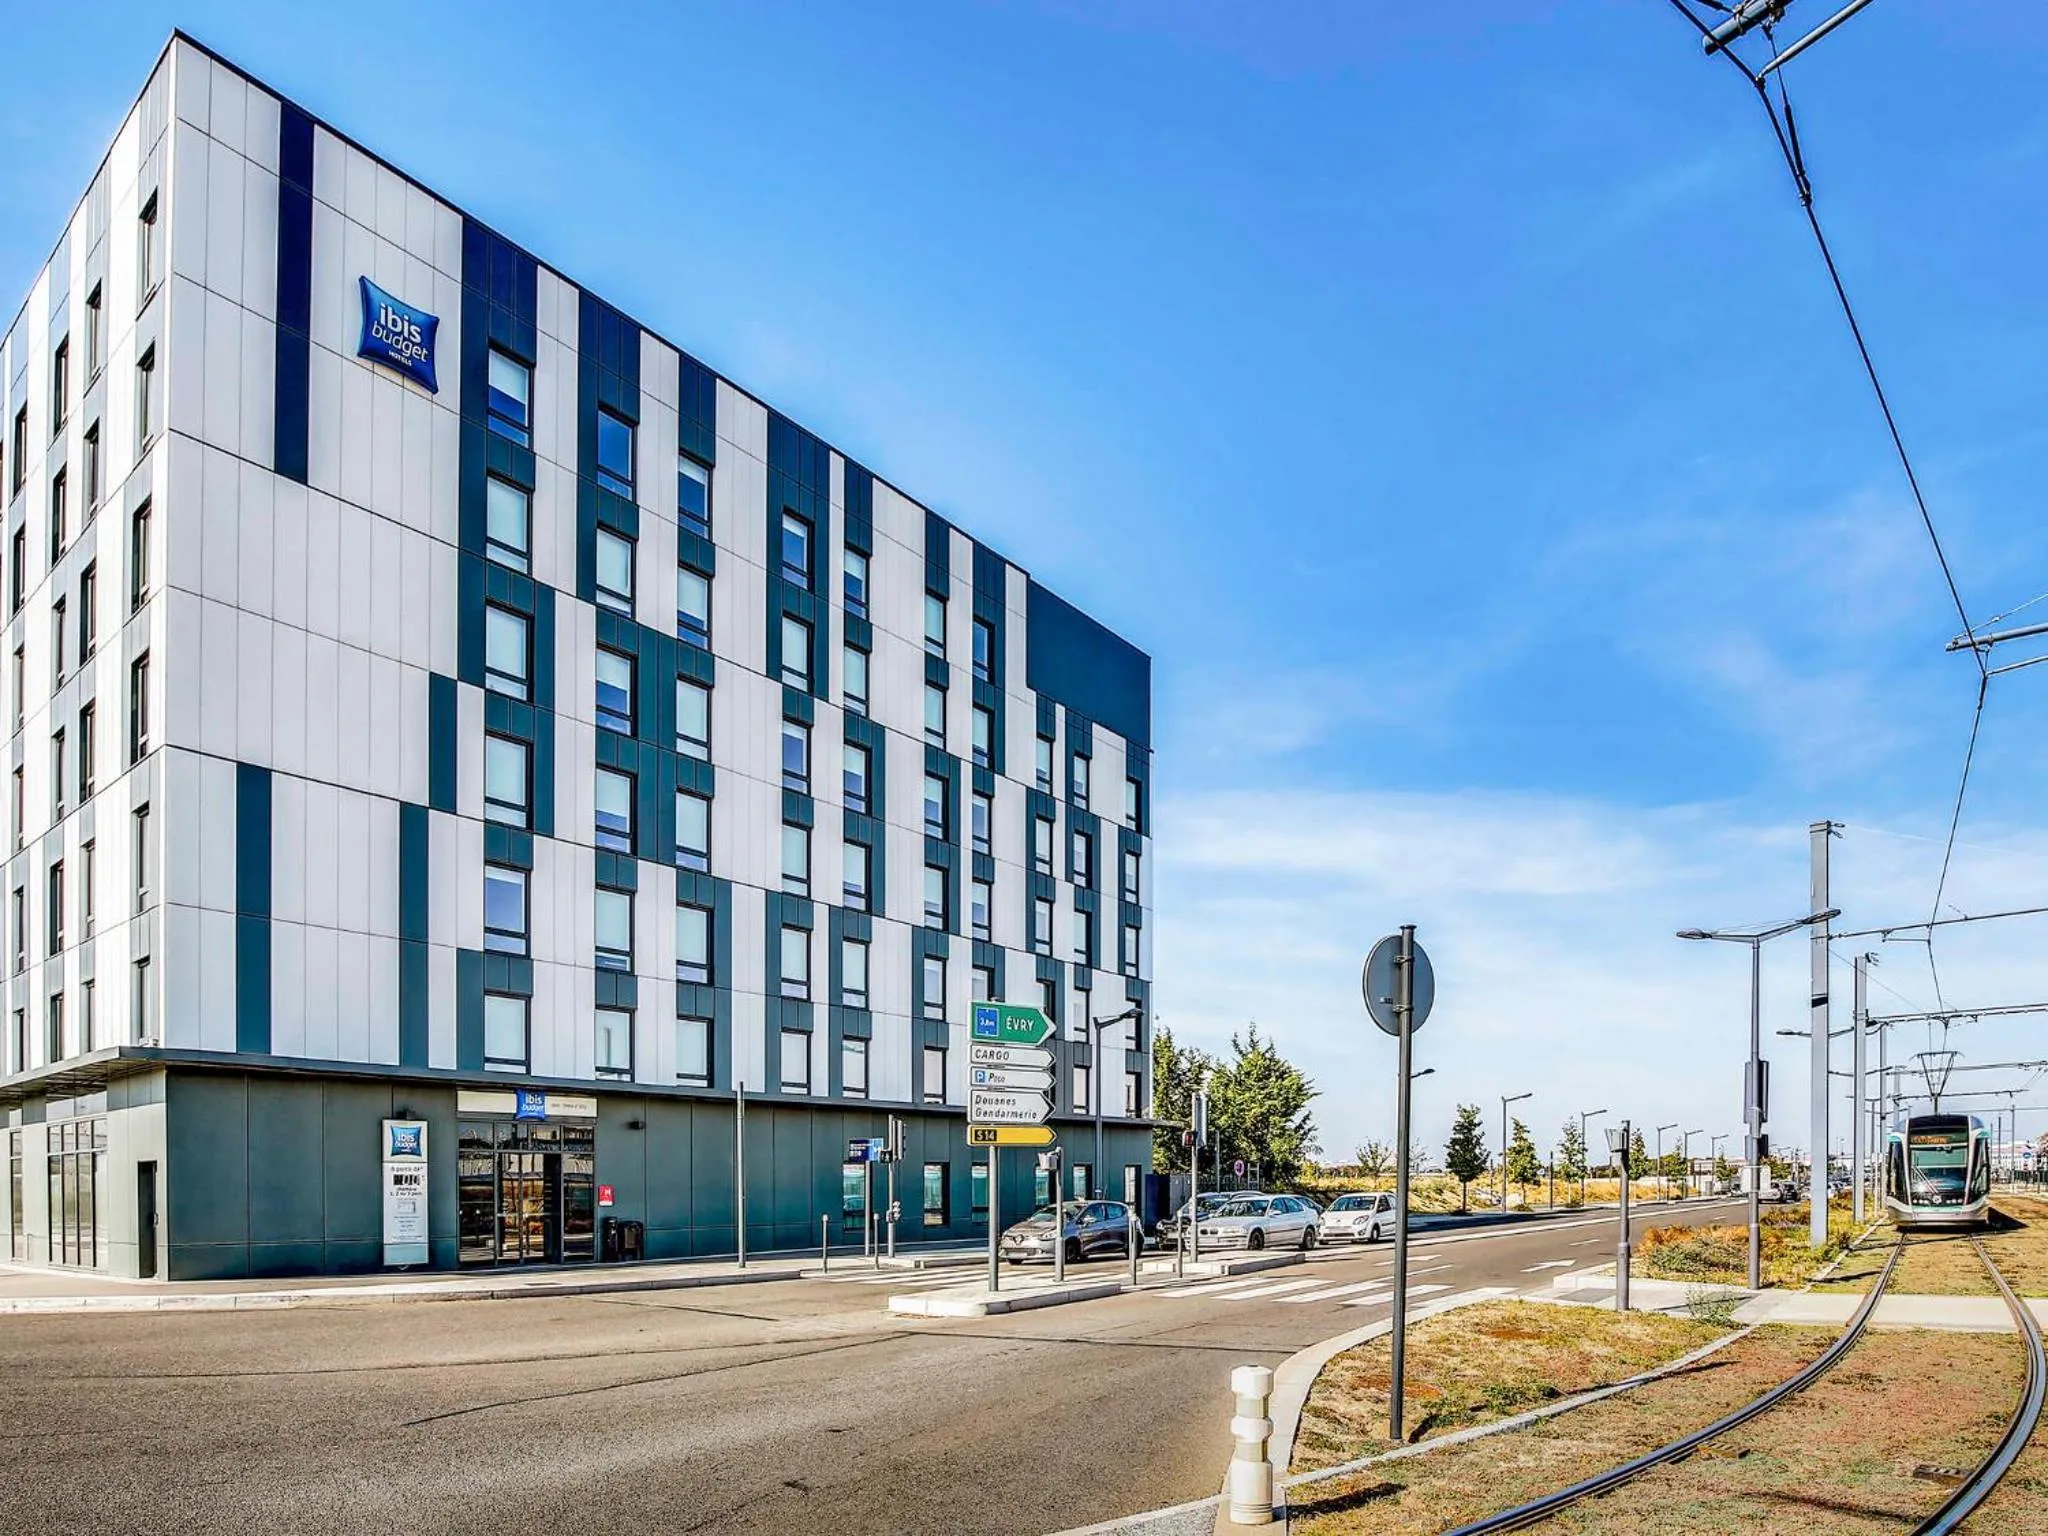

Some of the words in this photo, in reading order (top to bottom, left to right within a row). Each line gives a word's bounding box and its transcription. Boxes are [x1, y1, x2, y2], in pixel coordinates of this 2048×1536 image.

[380, 303, 422, 343] ibis
[372, 320, 429, 362] budget
[388, 349, 412, 366] HOTELS
[1005, 1015, 1034, 1031] ÉVRY
[974, 1049, 1010, 1060] CARGO
[525, 1093, 542, 1104] ibis
[975, 1095, 1017, 1105] Douanes
[521, 1103, 544, 1112] budget
[975, 1108, 1037, 1119] Gendarmerie
[397, 1132, 415, 1142] ibis
